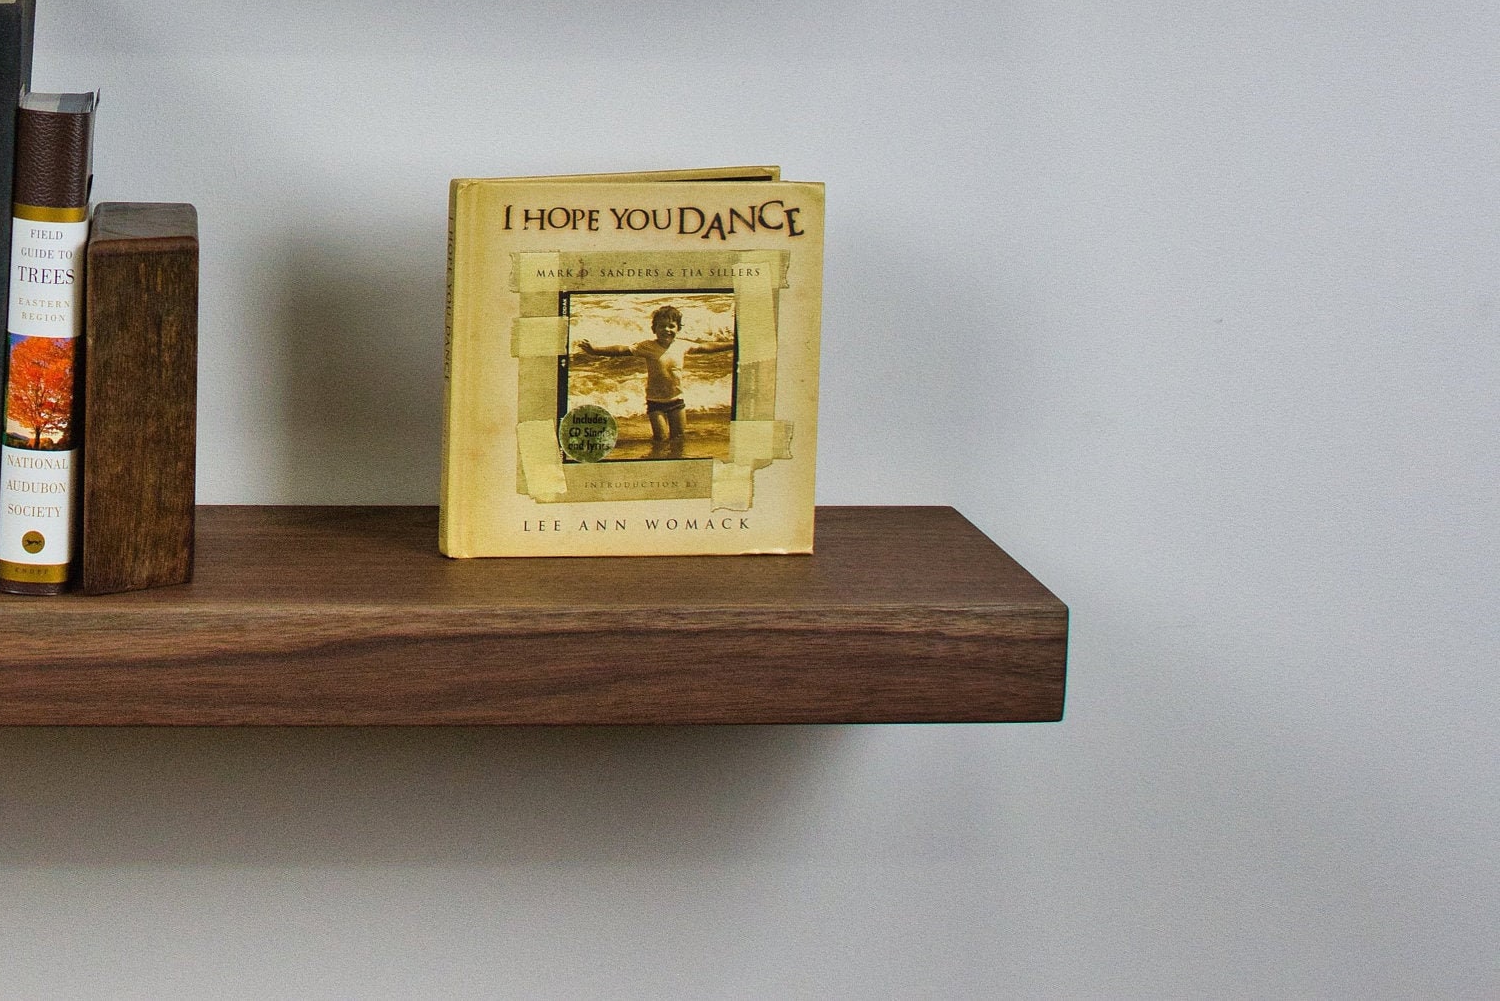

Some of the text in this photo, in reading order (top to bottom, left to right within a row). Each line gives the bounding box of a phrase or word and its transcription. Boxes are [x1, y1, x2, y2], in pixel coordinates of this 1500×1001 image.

[502, 200, 805, 241] I HOPE YOU DANCE
[30, 229, 63, 241] FIELD
[20, 247, 73, 260] GUIDE TO
[17, 265, 75, 285] TREES
[536, 268, 573, 279] MARK
[600, 267, 660, 278] SANDERS
[666, 267, 676, 278] &
[681, 267, 703, 277] TIA
[709, 267, 761, 277] SILLERS
[18, 298, 71, 308] EASTERN
[21, 312, 66, 322] REGION
[572, 414, 608, 425] Includes
[568, 427, 581, 438] CD
[568, 440, 584, 451] and
[6, 454, 69, 470] NATIONAL
[6, 480, 67, 494] AUDUBON
[584, 480, 679, 489] INTRODUCTION
[7, 504, 63, 518] SOCIETY
[523, 517, 751, 532] LEE ANN WOMACK
